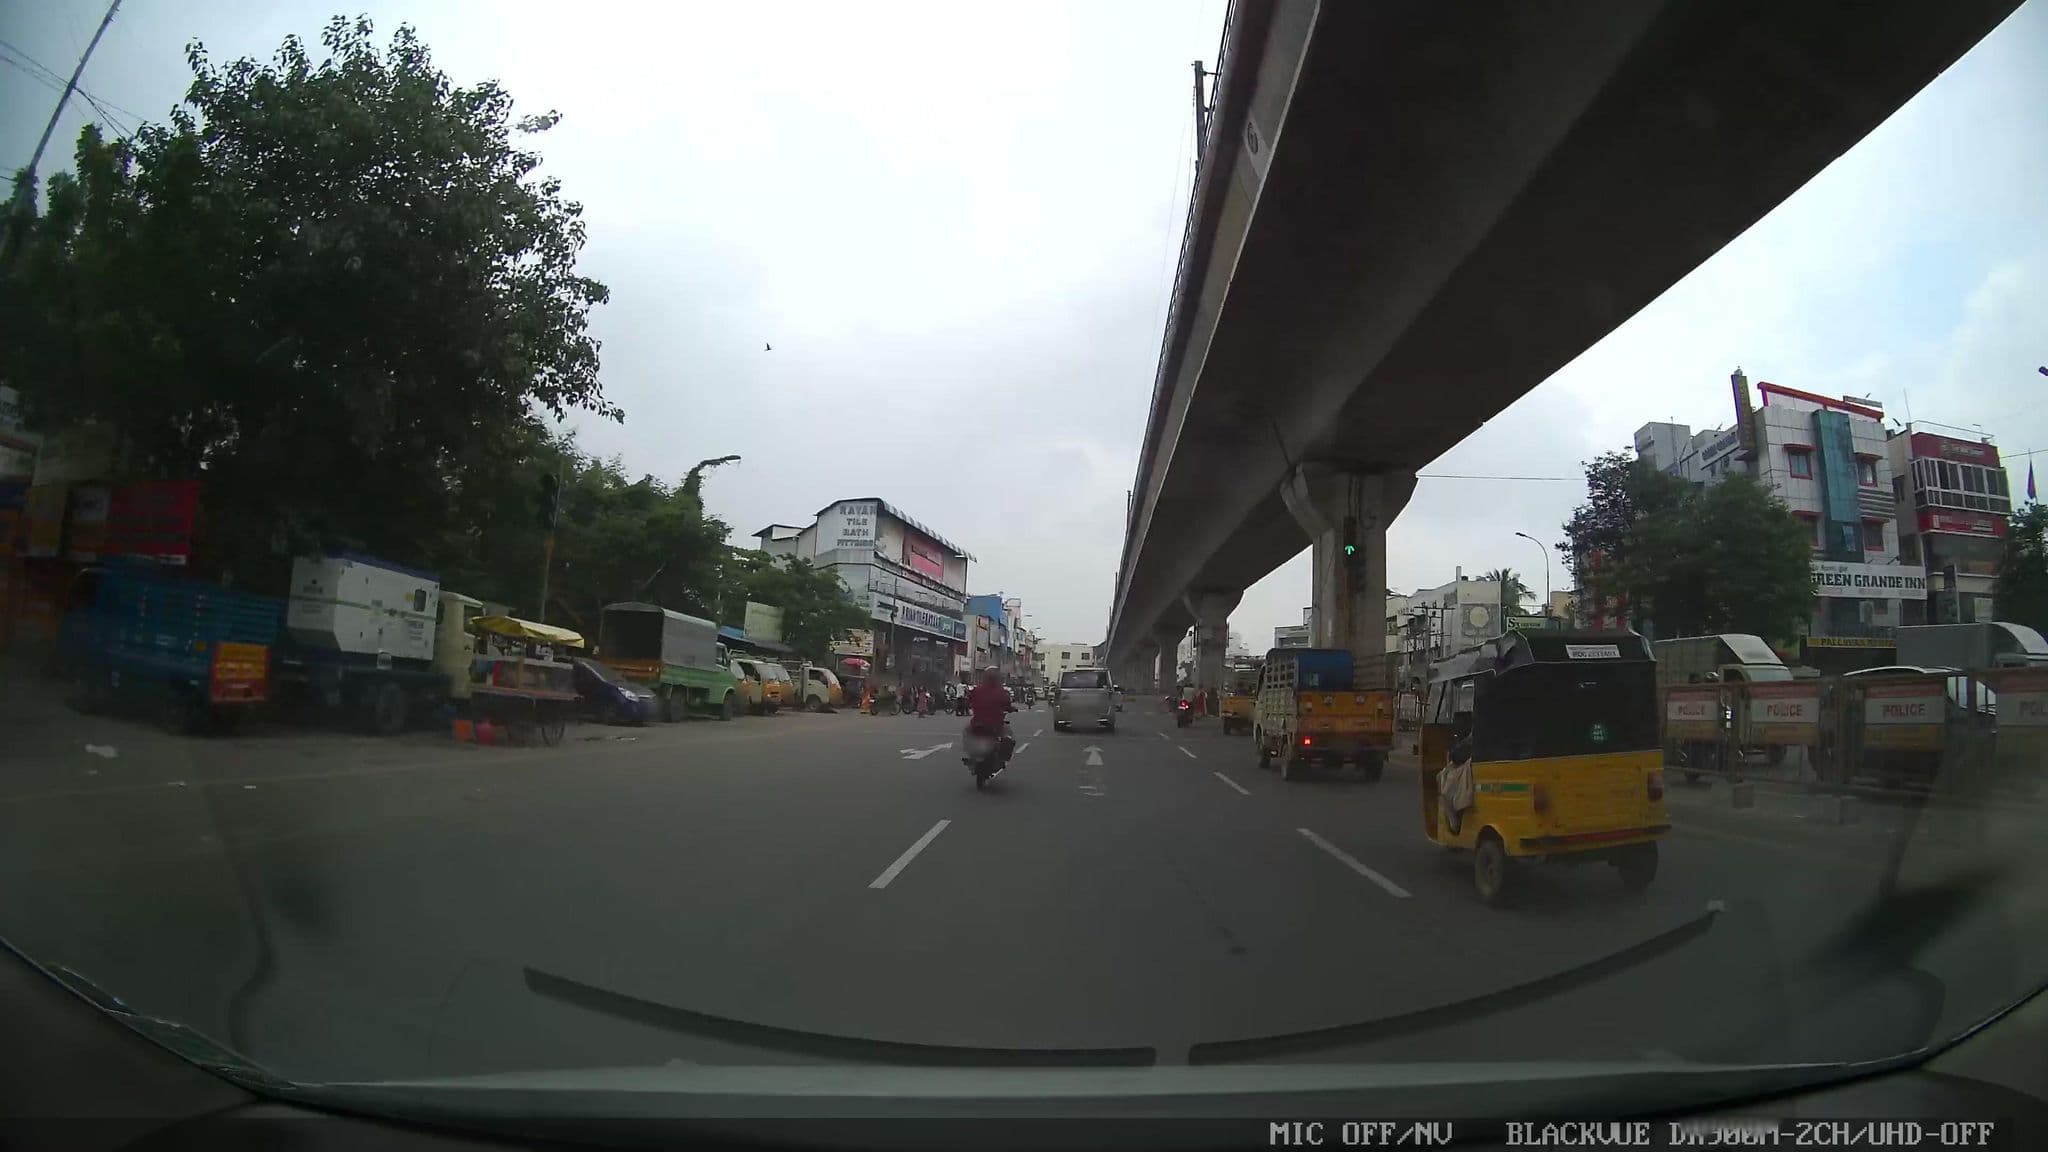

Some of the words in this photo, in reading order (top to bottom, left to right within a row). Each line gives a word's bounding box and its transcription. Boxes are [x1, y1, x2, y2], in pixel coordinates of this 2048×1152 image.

[846, 518, 868, 526] TILE
[1810, 572, 1852, 588] GREEN
[1854, 574, 1903, 589] GRANDE
[1904, 576, 1926, 590] INN
[1767, 704, 1803, 717] POLICE
[1882, 703, 1926, 717] POLICE
